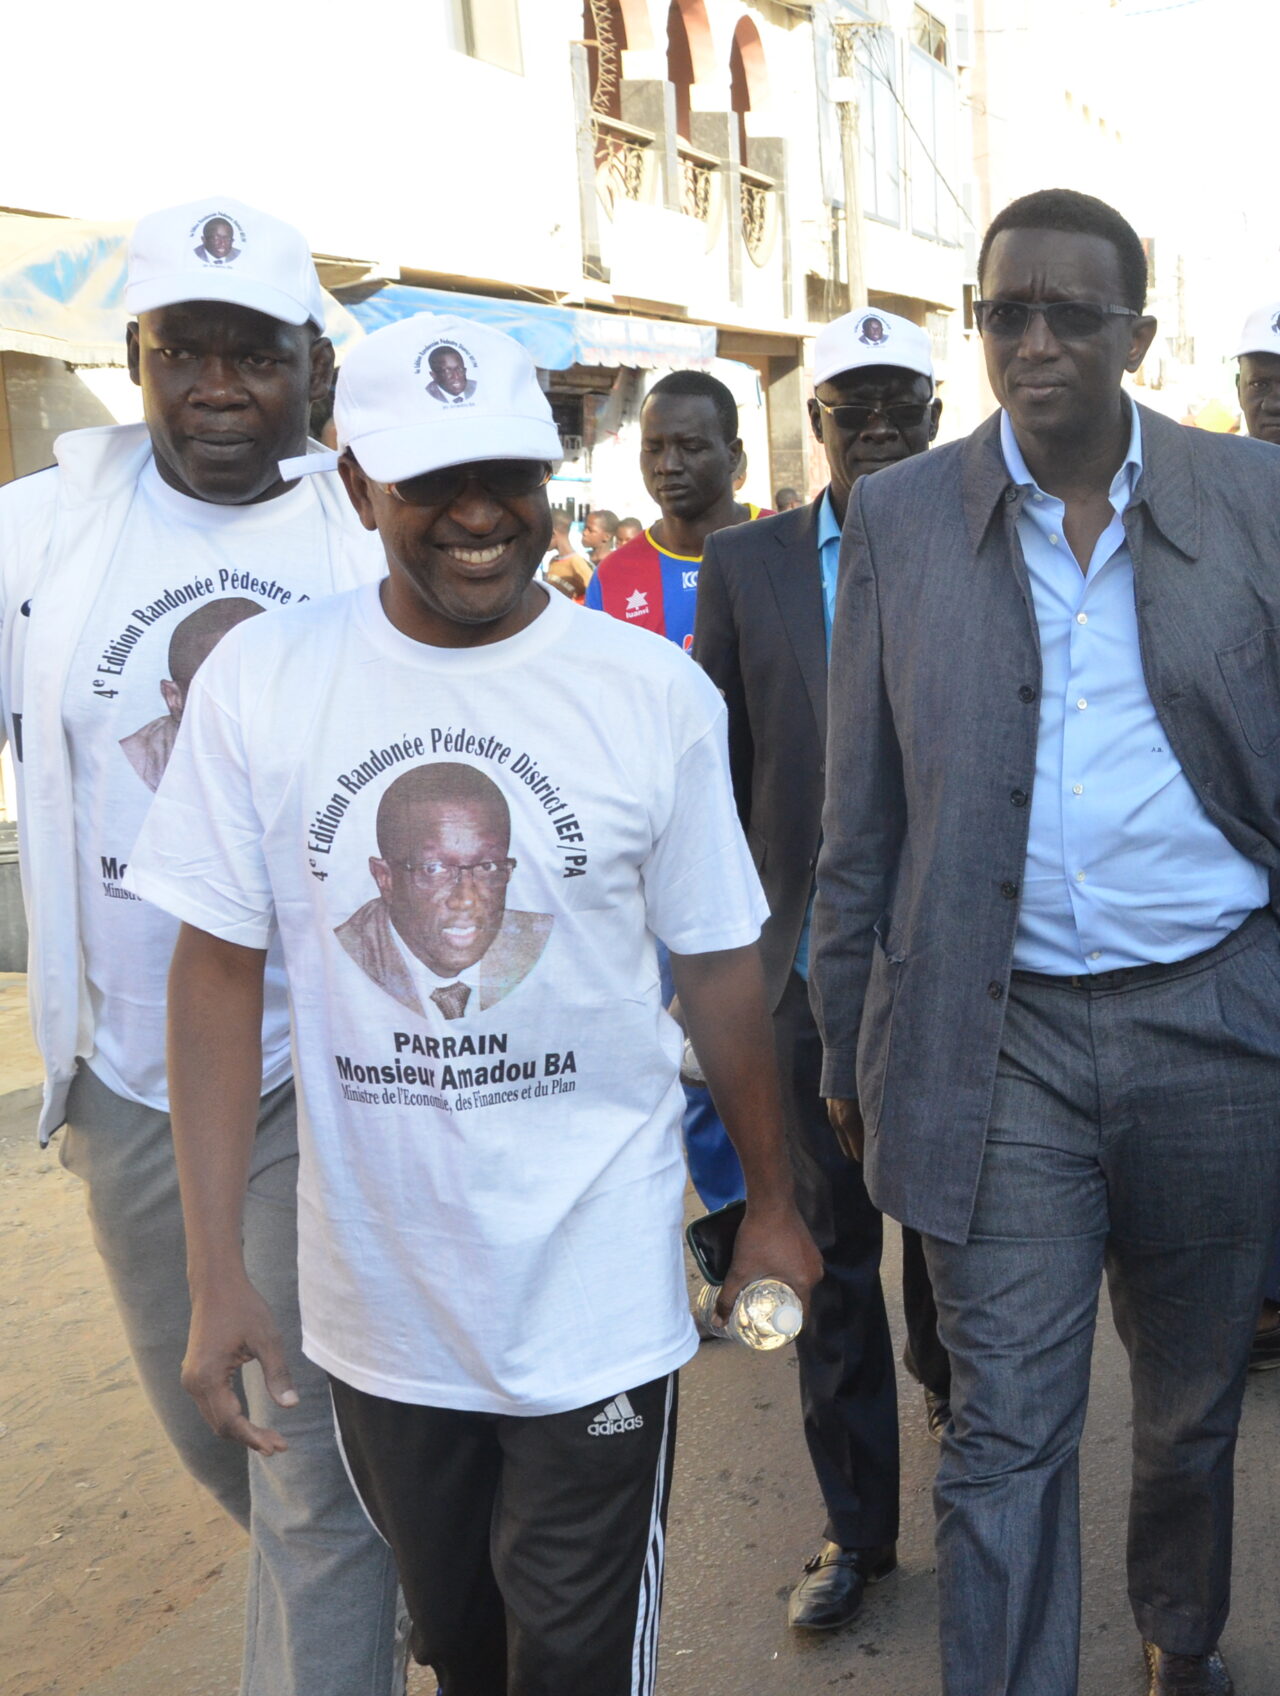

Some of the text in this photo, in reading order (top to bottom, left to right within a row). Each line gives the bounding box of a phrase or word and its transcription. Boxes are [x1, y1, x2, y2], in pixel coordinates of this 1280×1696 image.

[97, 621, 145, 676] Edition
[131, 574, 215, 628] Randonée
[218, 568, 292, 605] Pédestre
[307, 792, 351, 855] Edition
[336, 733, 425, 796] Randonée
[430, 726, 512, 764] Pédestre
[510, 752, 566, 816] District
[552, 812, 589, 879] IEF/PA
[393, 1031, 508, 1060] PARRAIN
[335, 1050, 577, 1091] Monsieur Amadou BA
[340, 1083, 380, 1106] Ministre
[381, 1086, 396, 1104] de
[455, 1096, 473, 1112] des
[473, 1086, 519, 1109] Finances
[521, 1087, 532, 1100] et
[534, 1083, 549, 1098] du
[551, 1077, 577, 1096] Plan
[586, 1415, 645, 1437] adidas
